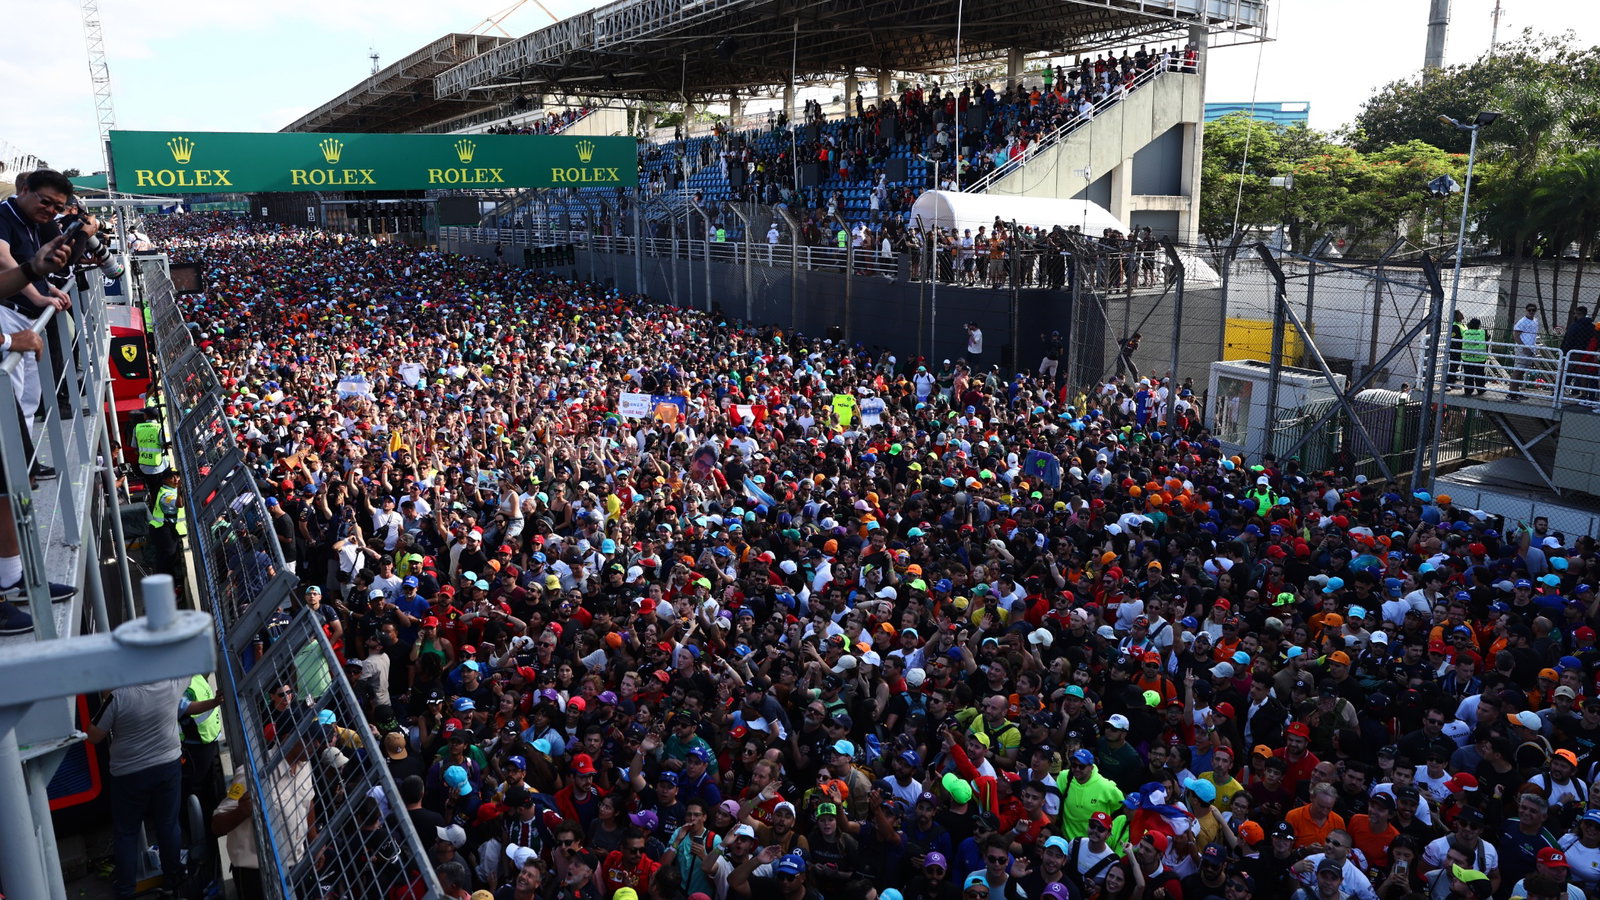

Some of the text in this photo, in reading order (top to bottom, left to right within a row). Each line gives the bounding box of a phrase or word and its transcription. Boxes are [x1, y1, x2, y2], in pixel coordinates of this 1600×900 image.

[135, 169, 233, 187] ROLEX
[290, 169, 376, 185] ROLEX
[428, 168, 505, 184] ROLEX
[551, 167, 620, 182] ROLEX
